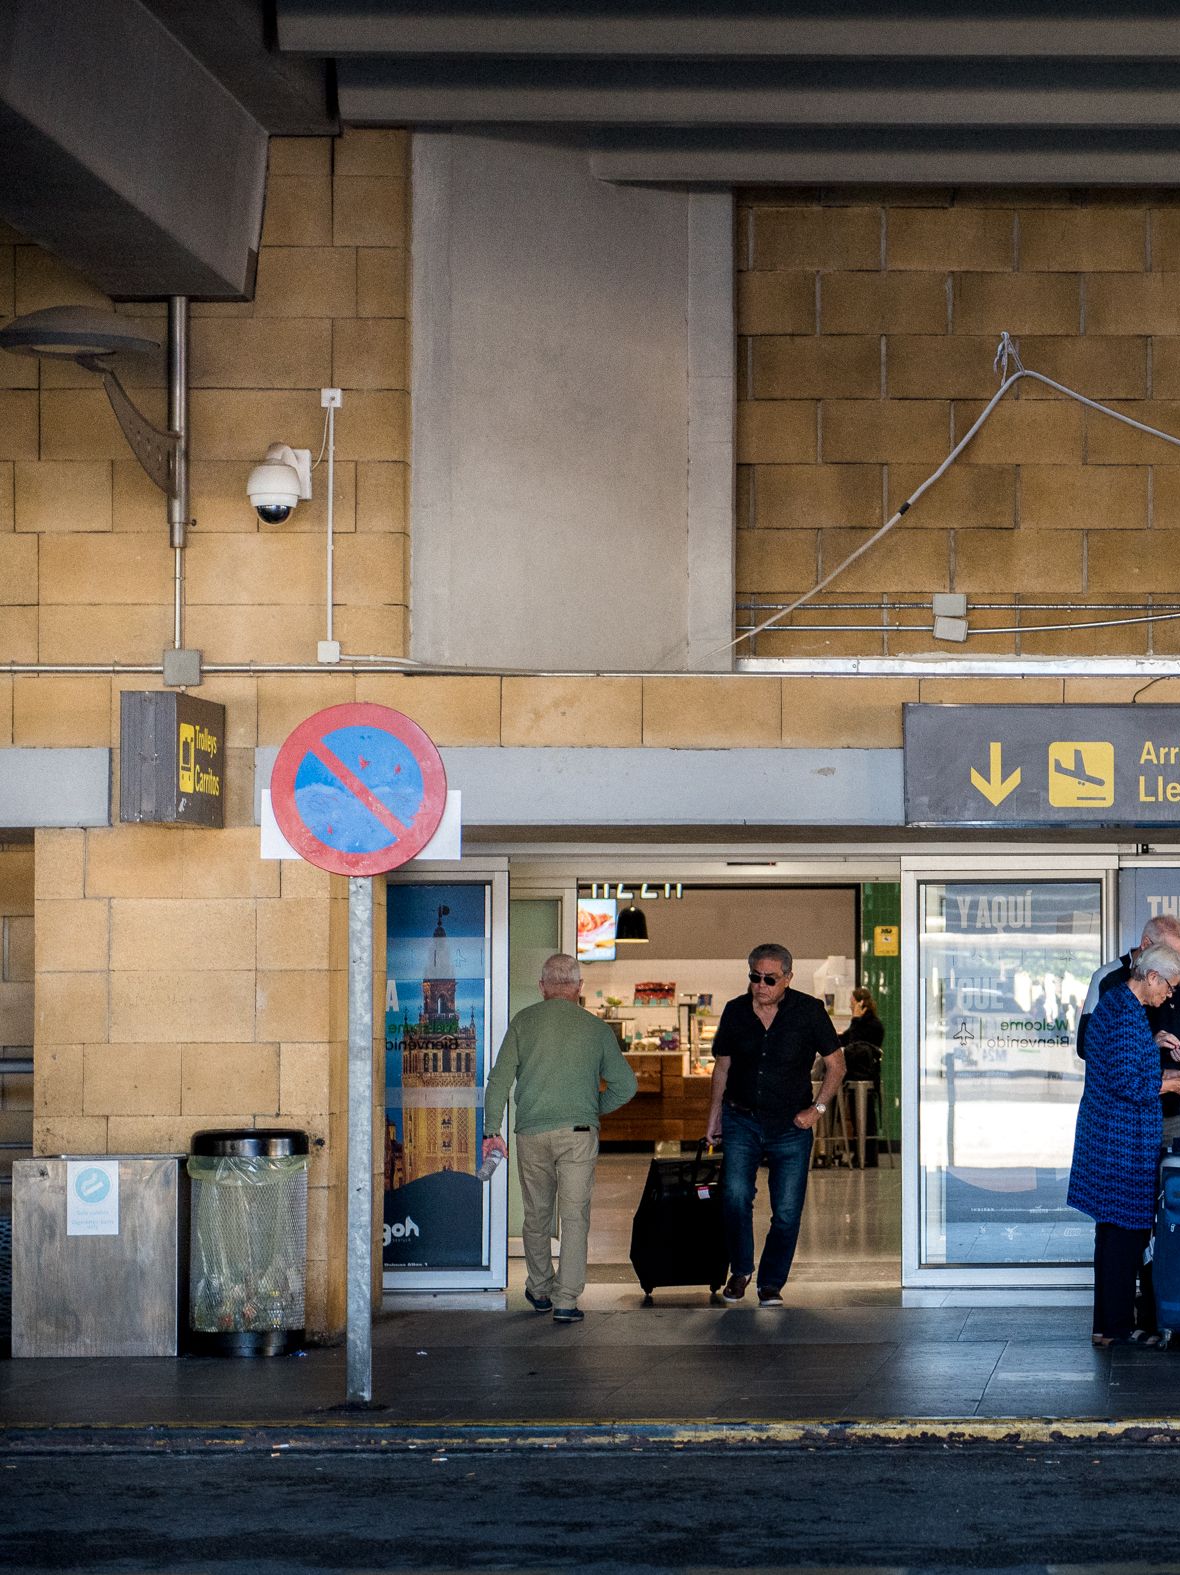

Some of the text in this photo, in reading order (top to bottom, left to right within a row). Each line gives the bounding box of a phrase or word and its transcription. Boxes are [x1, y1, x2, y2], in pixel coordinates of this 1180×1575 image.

[195, 726, 217, 758] Trolleys
[195, 764, 220, 796] Carritos
[957, 889, 1033, 934] Y AQUÍ
